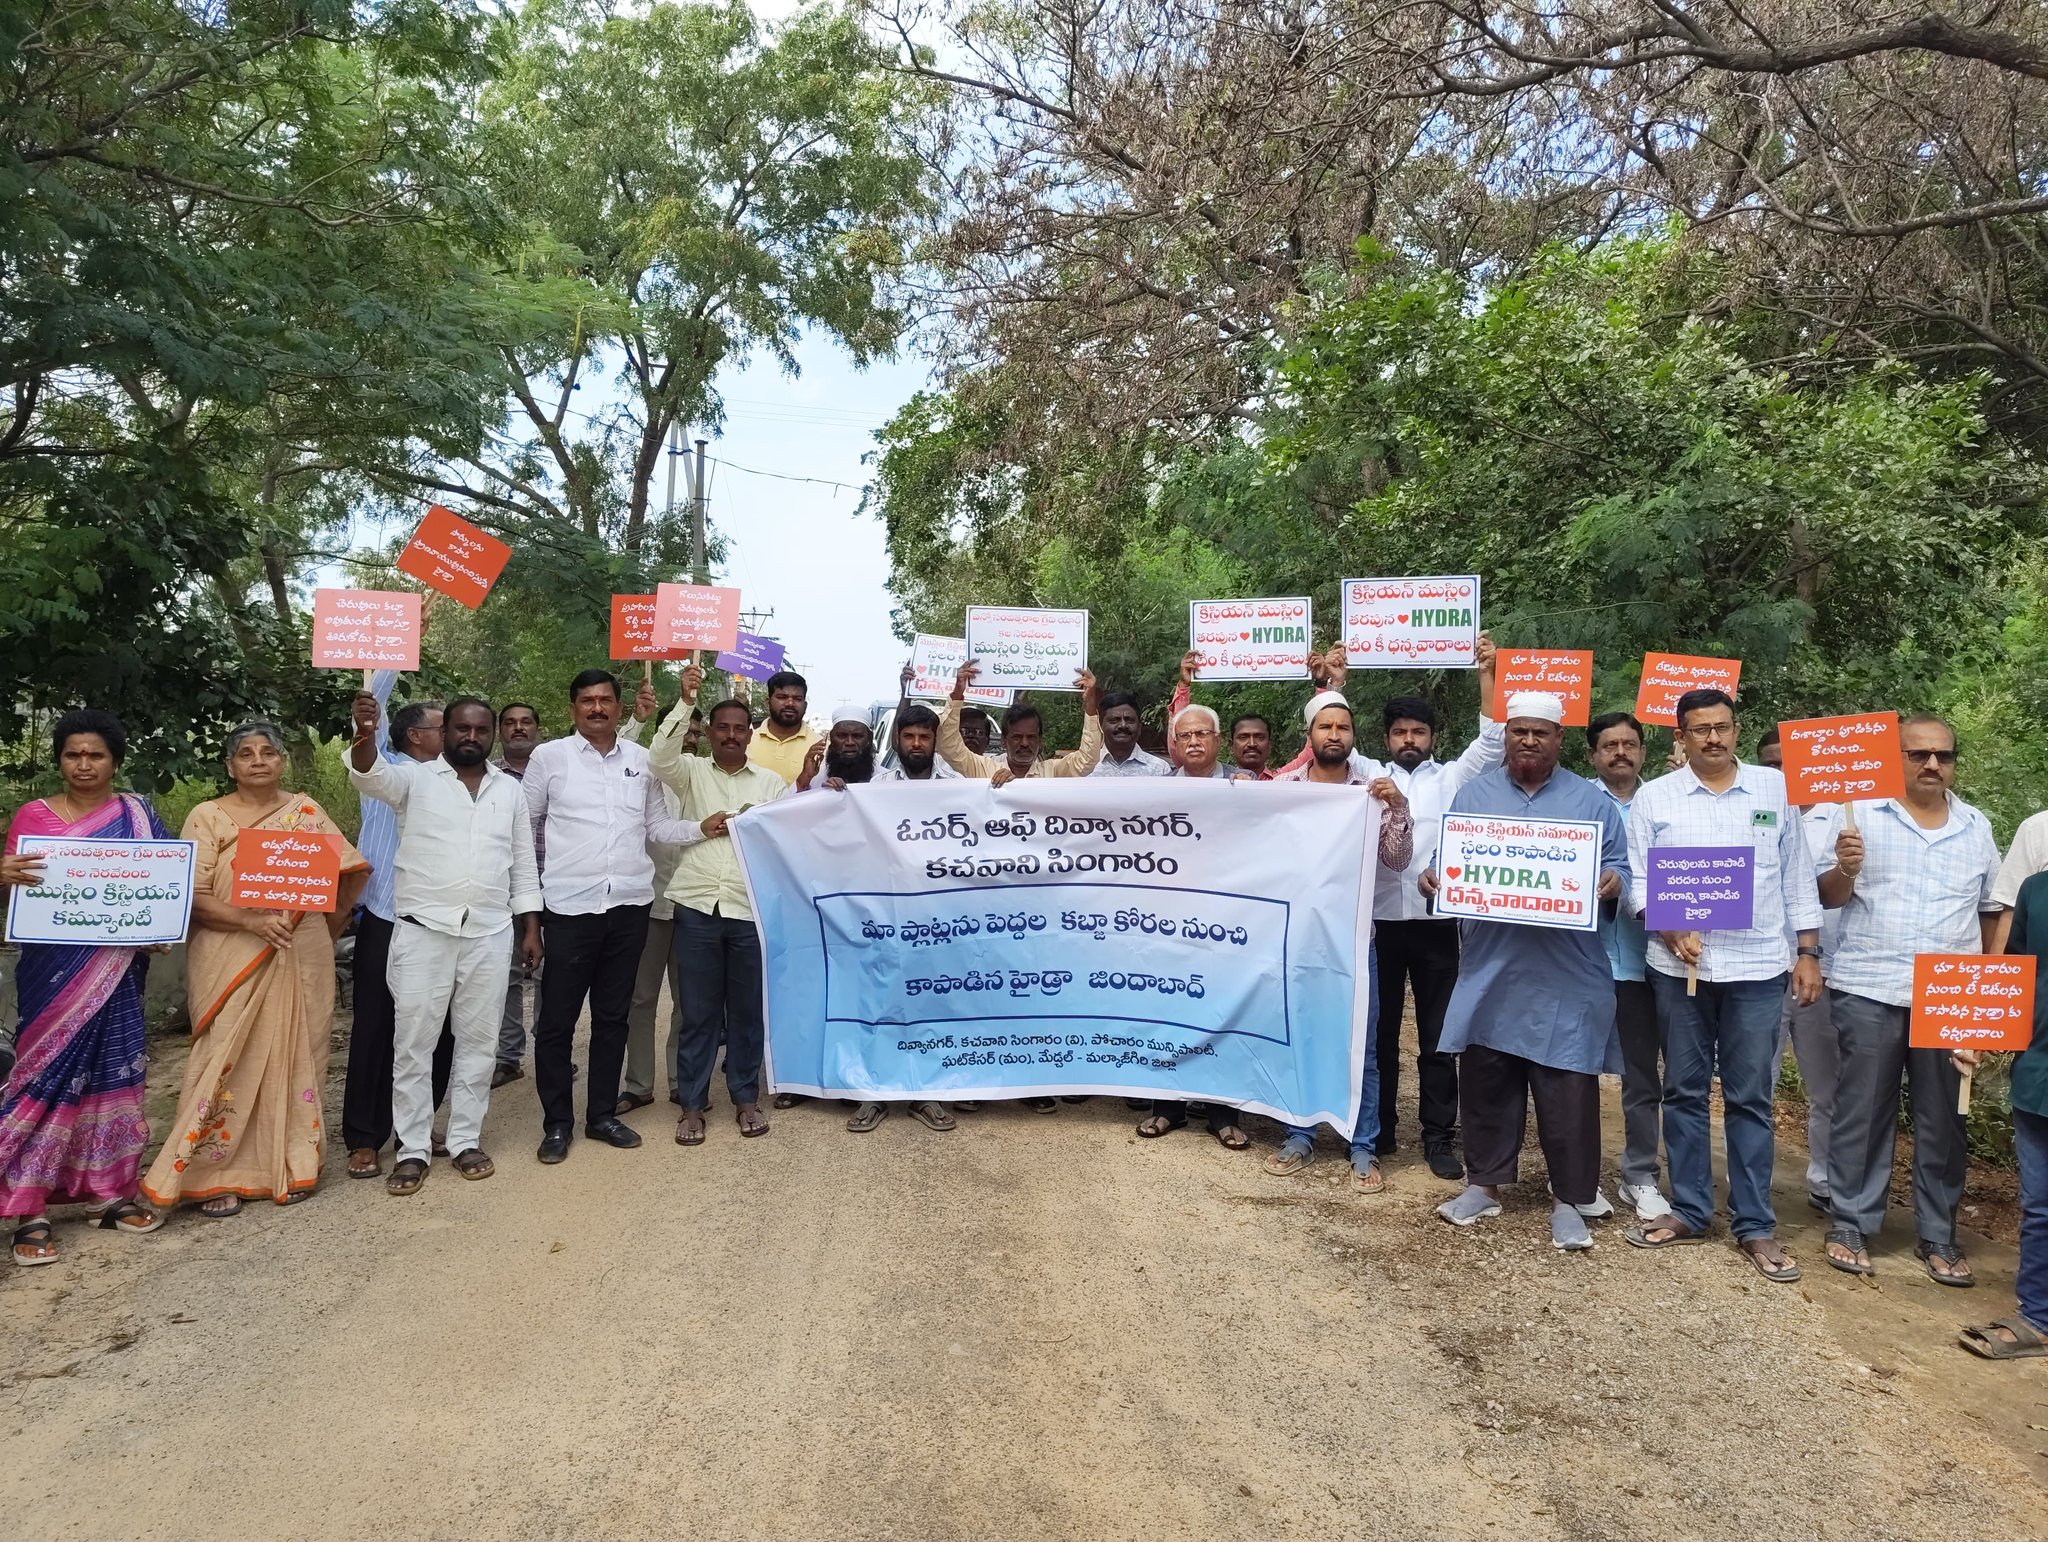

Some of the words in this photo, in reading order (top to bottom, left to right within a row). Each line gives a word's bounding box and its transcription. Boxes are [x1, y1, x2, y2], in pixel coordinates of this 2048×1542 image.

[1352, 582, 1414, 605] క్రిస్టియన్
[1418, 582, 1471, 602] ముస్లిం
[336, 599, 380, 611] చెరువులు
[1199, 604, 1254, 624] క్రిస్టియన్
[1258, 604, 1304, 620] ముస్లిం
[1349, 614, 1395, 628] తరపున
[1411, 608, 1472, 627] HYDRA
[1196, 632, 1238, 644] తరపున
[1252, 626, 1305, 644] HYDRA
[323, 648, 354, 659] కాపాడి
[974, 641, 1020, 658] ముస్లిం
[1024, 641, 1078, 660] క్రిస్టియన్
[1348, 634, 1371, 652] టీం
[1388, 638, 1471, 658] ధన్యవాదాలు
[1231, 653, 1305, 671] ధన్యవాదాలు
[1511, 655, 1527, 665] భూ
[1551, 656, 1581, 665] దారుల
[993, 660, 1060, 681] కమ్యూనిటీ
[1505, 671, 1532, 683] నుంచి
[1646, 677, 1694, 688] భూములుగా
[1790, 728, 1835, 742] దశాబ్దాల
[1839, 722, 1887, 737] పూడికను
[1799, 762, 1847, 778] నాలాలకు
[1851, 760, 1882, 771] ఊపిరి
[1809, 780, 1841, 794] పోసిన
[1844, 780, 1875, 793] హైడ్రా
[896, 813, 979, 847] ఓనర్స్
[984, 811, 1037, 842] ఆఫ్
[1045, 815, 1117, 843] దివ్యా
[1120, 812, 1202, 841] నగర్,
[1447, 819, 1484, 837] ముస్లిం
[1486, 822, 1534, 841] క్రిస్టియన్
[1538, 827, 1594, 842] సమాధుల
[60, 847, 130, 861] సంవత్సరాల
[1506, 845, 1577, 863] కాపాడిన
[926, 854, 1041, 879] కచవాని
[1047, 848, 1179, 875] సింగారం
[1656, 859, 1710, 871] చెరువులను
[1712, 856, 1746, 868] కాపాడి
[66, 868, 86, 878] కల
[89, 867, 151, 879] నెరవేరింది
[1464, 864, 1552, 890] HYDRA
[1561, 878, 1580, 891] కు
[1667, 875, 1700, 885] వరదల
[1702, 875, 1732, 884] నుంచి
[25, 883, 97, 905] ముస్లిం
[102, 882, 181, 907] క్రిస్టియన్
[240, 890, 260, 898] దారి
[264, 890, 298, 903] చూపిన
[300, 893, 327, 905] హైడ్రా
[1446, 886, 1583, 915] ధన్యవాదాలు
[1657, 891, 1698, 904] నగరాన్ని
[1698, 889, 1740, 900] కాపాడిన
[52, 906, 152, 934] కమ్యూనిటీ
[1685, 907, 1712, 920] హైడ్రా
[861, 919, 896, 940] మా
[900, 915, 981, 948] ప్లాట్లను
[985, 911, 1047, 941] పెద్దల
[1061, 910, 1108, 941] కబ్జా
[1114, 907, 1177, 936] కోరల
[1182, 917, 1248, 946] నుంచి
[1933, 961, 1955, 975] భూ
[1958, 961, 1981, 980] కబ్జా
[1984, 962, 2021, 974] దారుల
[905, 970, 1004, 997] కాపాడిన
[1008, 970, 1073, 998] హైడ్రా
[1088, 970, 1205, 999] జిందాబాద్
[1925, 982, 1962, 997] నుంచి
[1924, 1003, 1970, 1019] కాపాడిన
[1972, 1006, 2005, 1021] హైడ్రా
[2008, 1005, 2022, 1018] కు
[1939, 1025, 2005, 1043] ధన్యవాదాలు
[897, 1035, 958, 1054] దివ్యానగర్,
[961, 1036, 1008, 1048] కచవాని
[1011, 1034, 1062, 1046] సింగారం
[1091, 1034, 1144, 1048] పోచారం
[1039, 1049, 1073, 1068] మేడ్చల్
